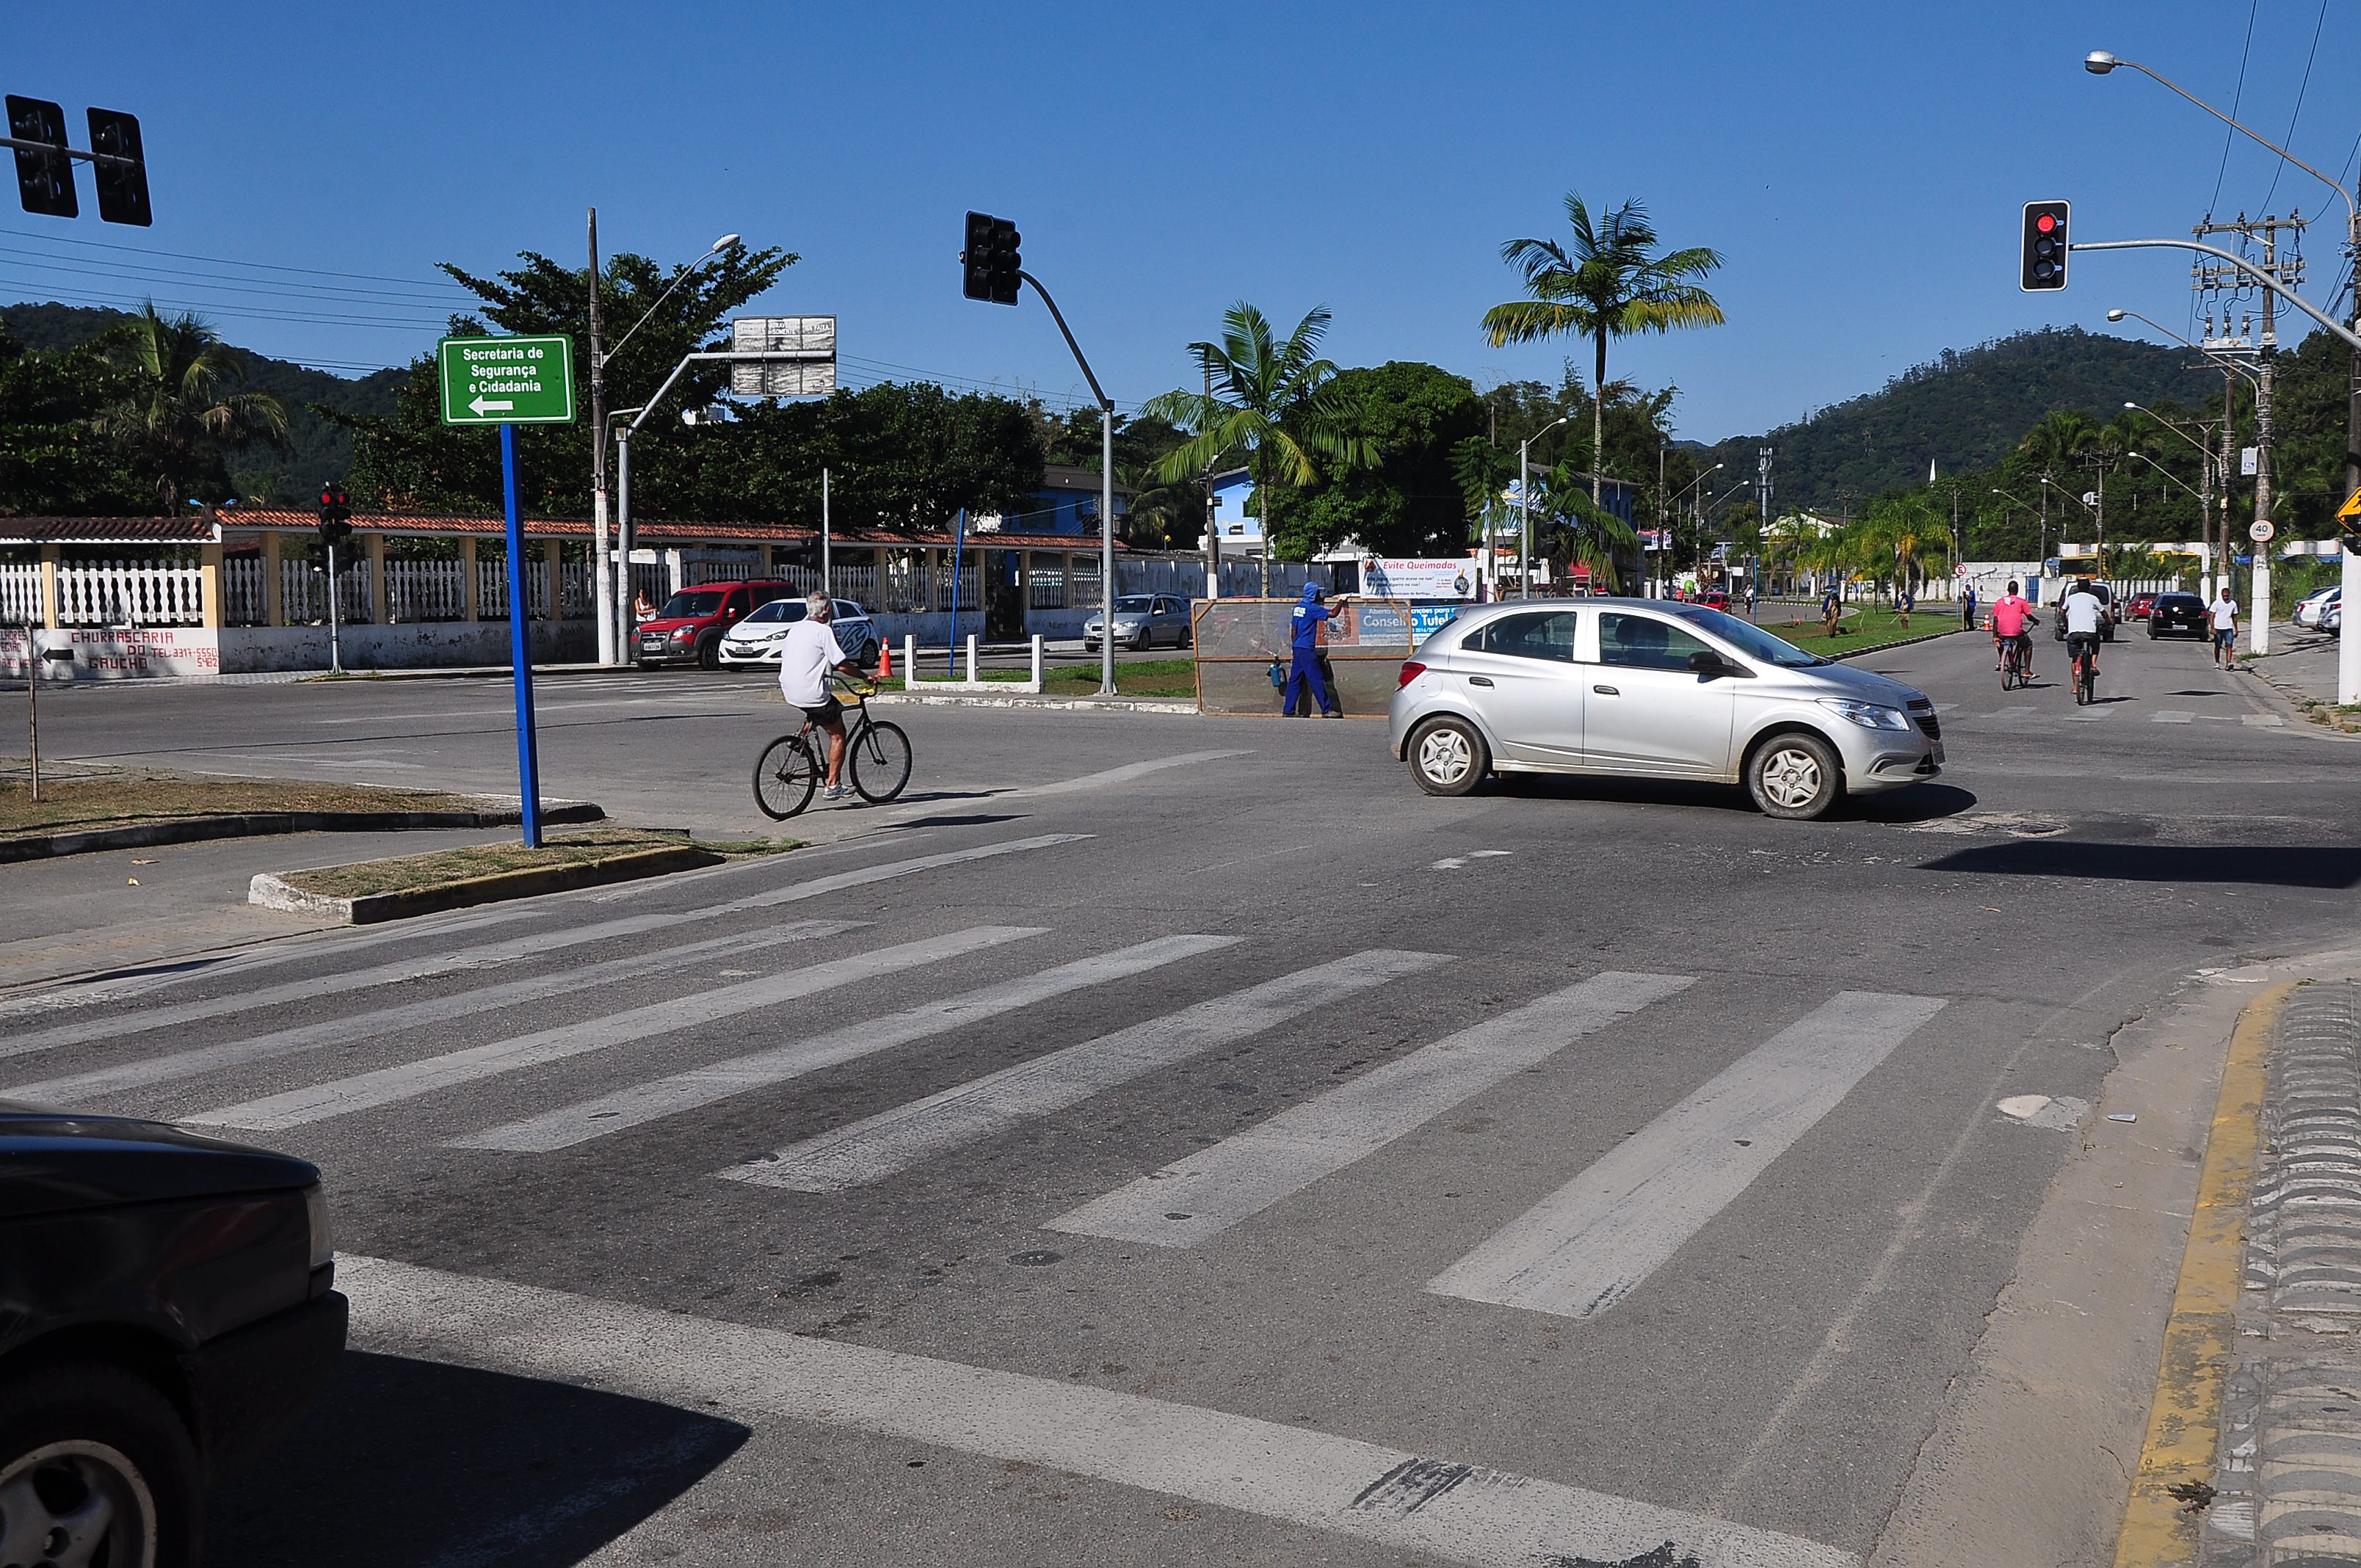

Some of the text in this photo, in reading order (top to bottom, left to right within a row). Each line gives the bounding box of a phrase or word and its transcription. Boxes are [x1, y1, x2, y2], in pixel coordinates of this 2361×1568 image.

[463, 346, 544, 360] Secretaria de
[471, 364, 537, 379] Segurança
[468, 379, 542, 393] e Cidadania
[2255, 524, 2268, 533] 40
[1383, 561, 1457, 570] Evite Queimadas
[1421, 612, 1454, 626] Tutel
[0, 630, 26, 641] LHORES
[71, 631, 174, 644] CHURRASCARIA
[127, 645, 145, 656] DO
[173, 647, 218, 658] 3317-5550
[197, 658, 218, 667] 5482
